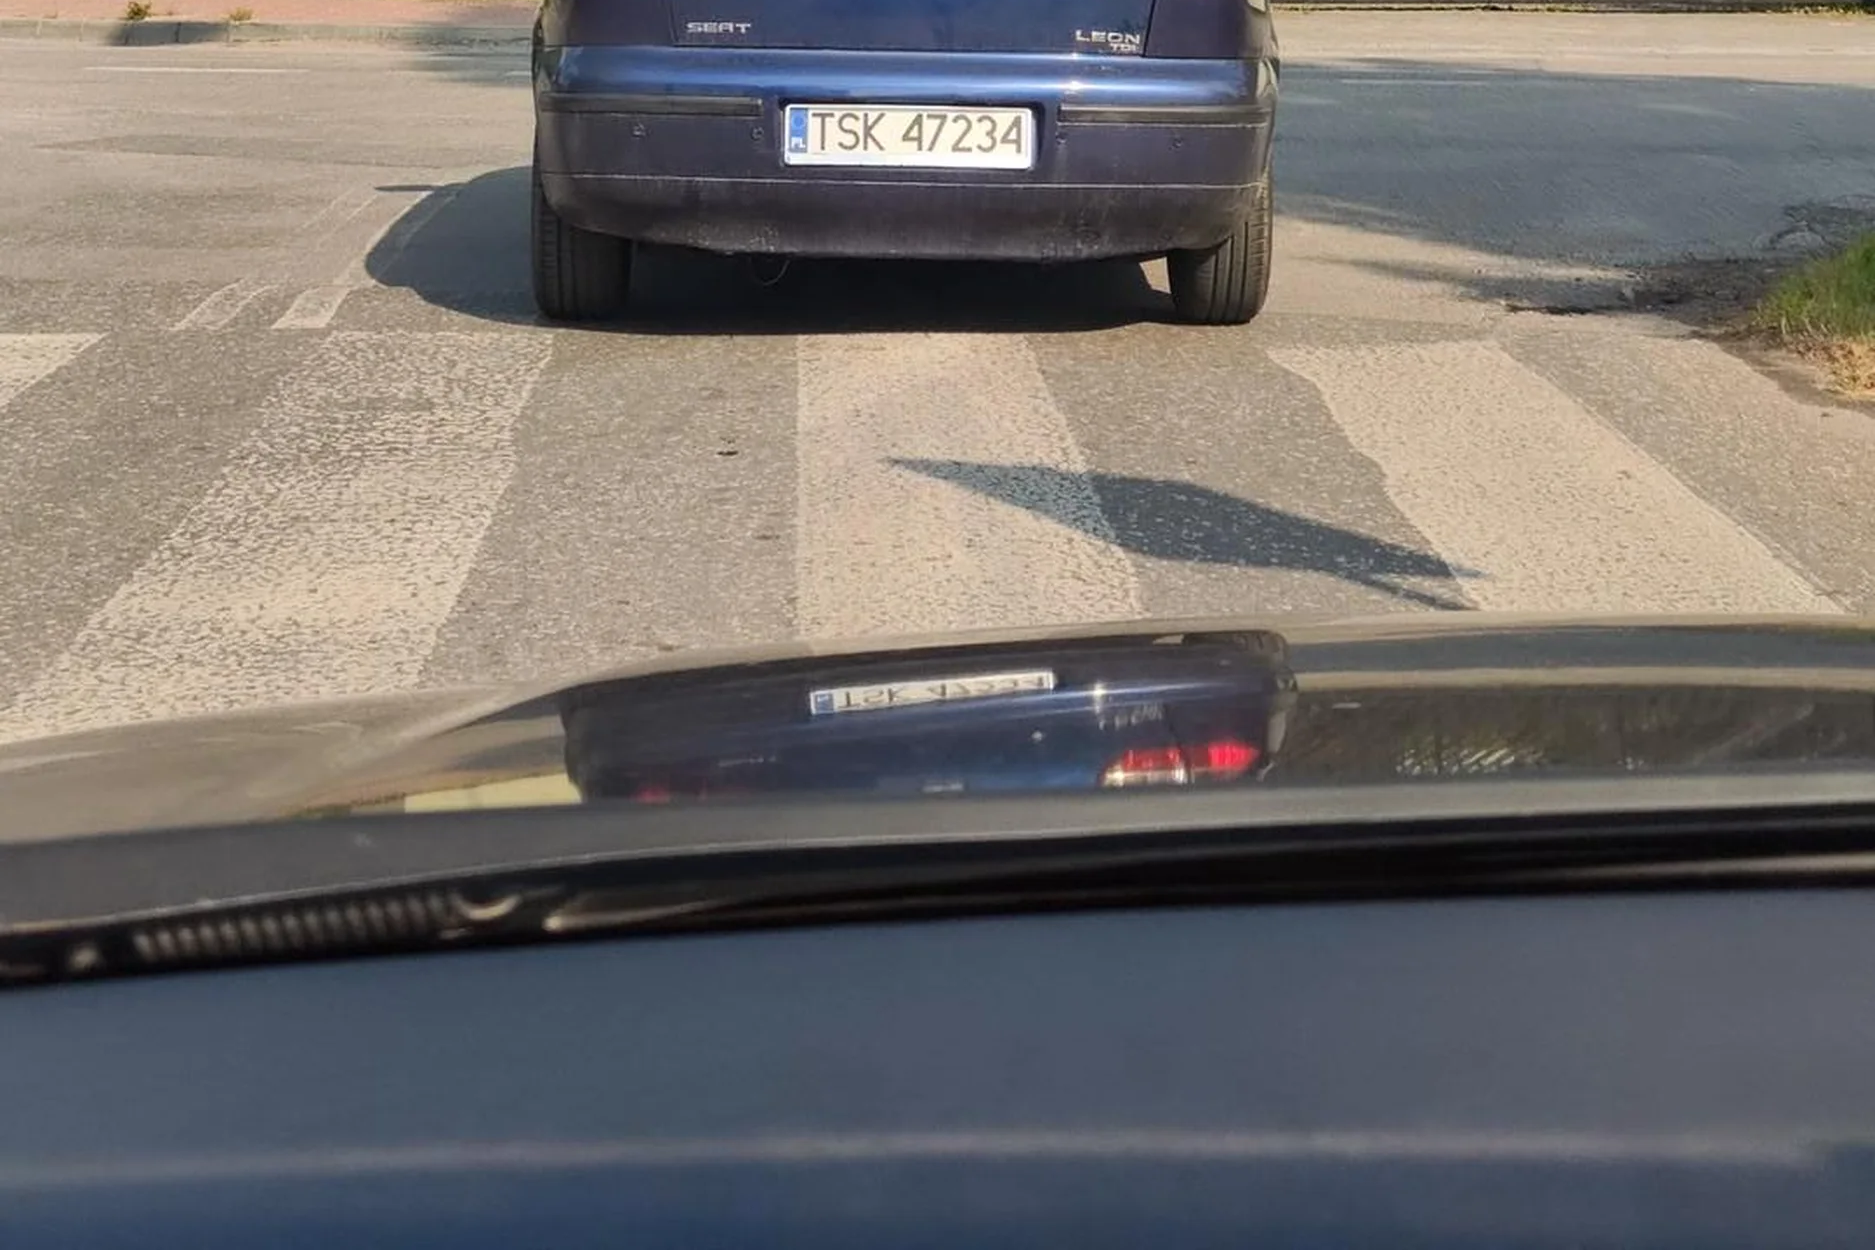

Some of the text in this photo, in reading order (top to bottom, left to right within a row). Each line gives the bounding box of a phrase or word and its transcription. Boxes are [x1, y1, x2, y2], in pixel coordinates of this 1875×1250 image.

[686, 21, 752, 34] SEAT
[1075, 29, 1141, 44] LEON
[811, 112, 1022, 154] TSK 47234
